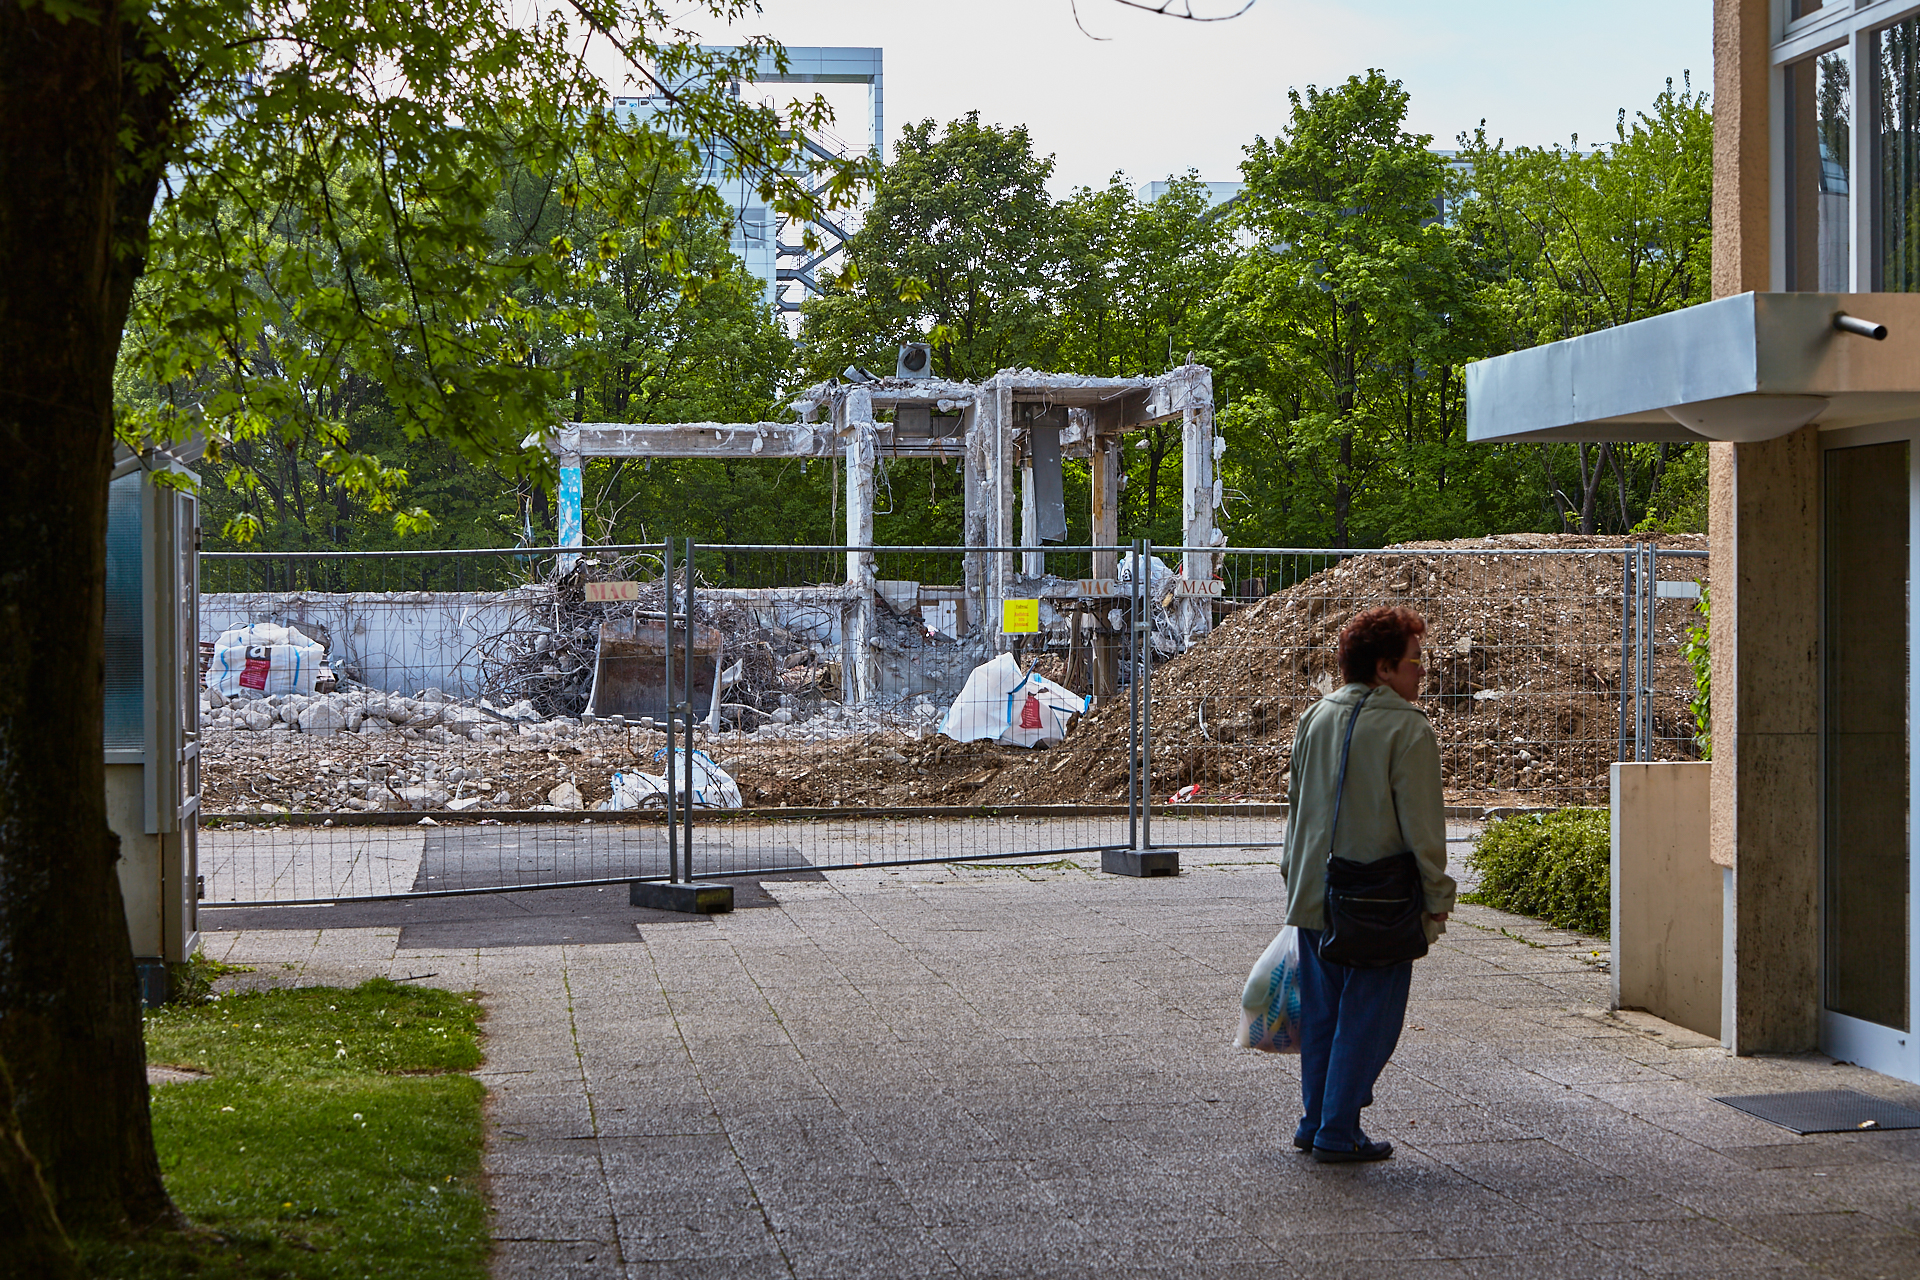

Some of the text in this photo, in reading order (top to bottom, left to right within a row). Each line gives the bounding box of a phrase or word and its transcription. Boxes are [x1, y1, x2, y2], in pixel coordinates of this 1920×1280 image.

[589, 583, 634, 600] MAC
[1080, 580, 1113, 595] MAC
[1182, 580, 1219, 595] MAC
